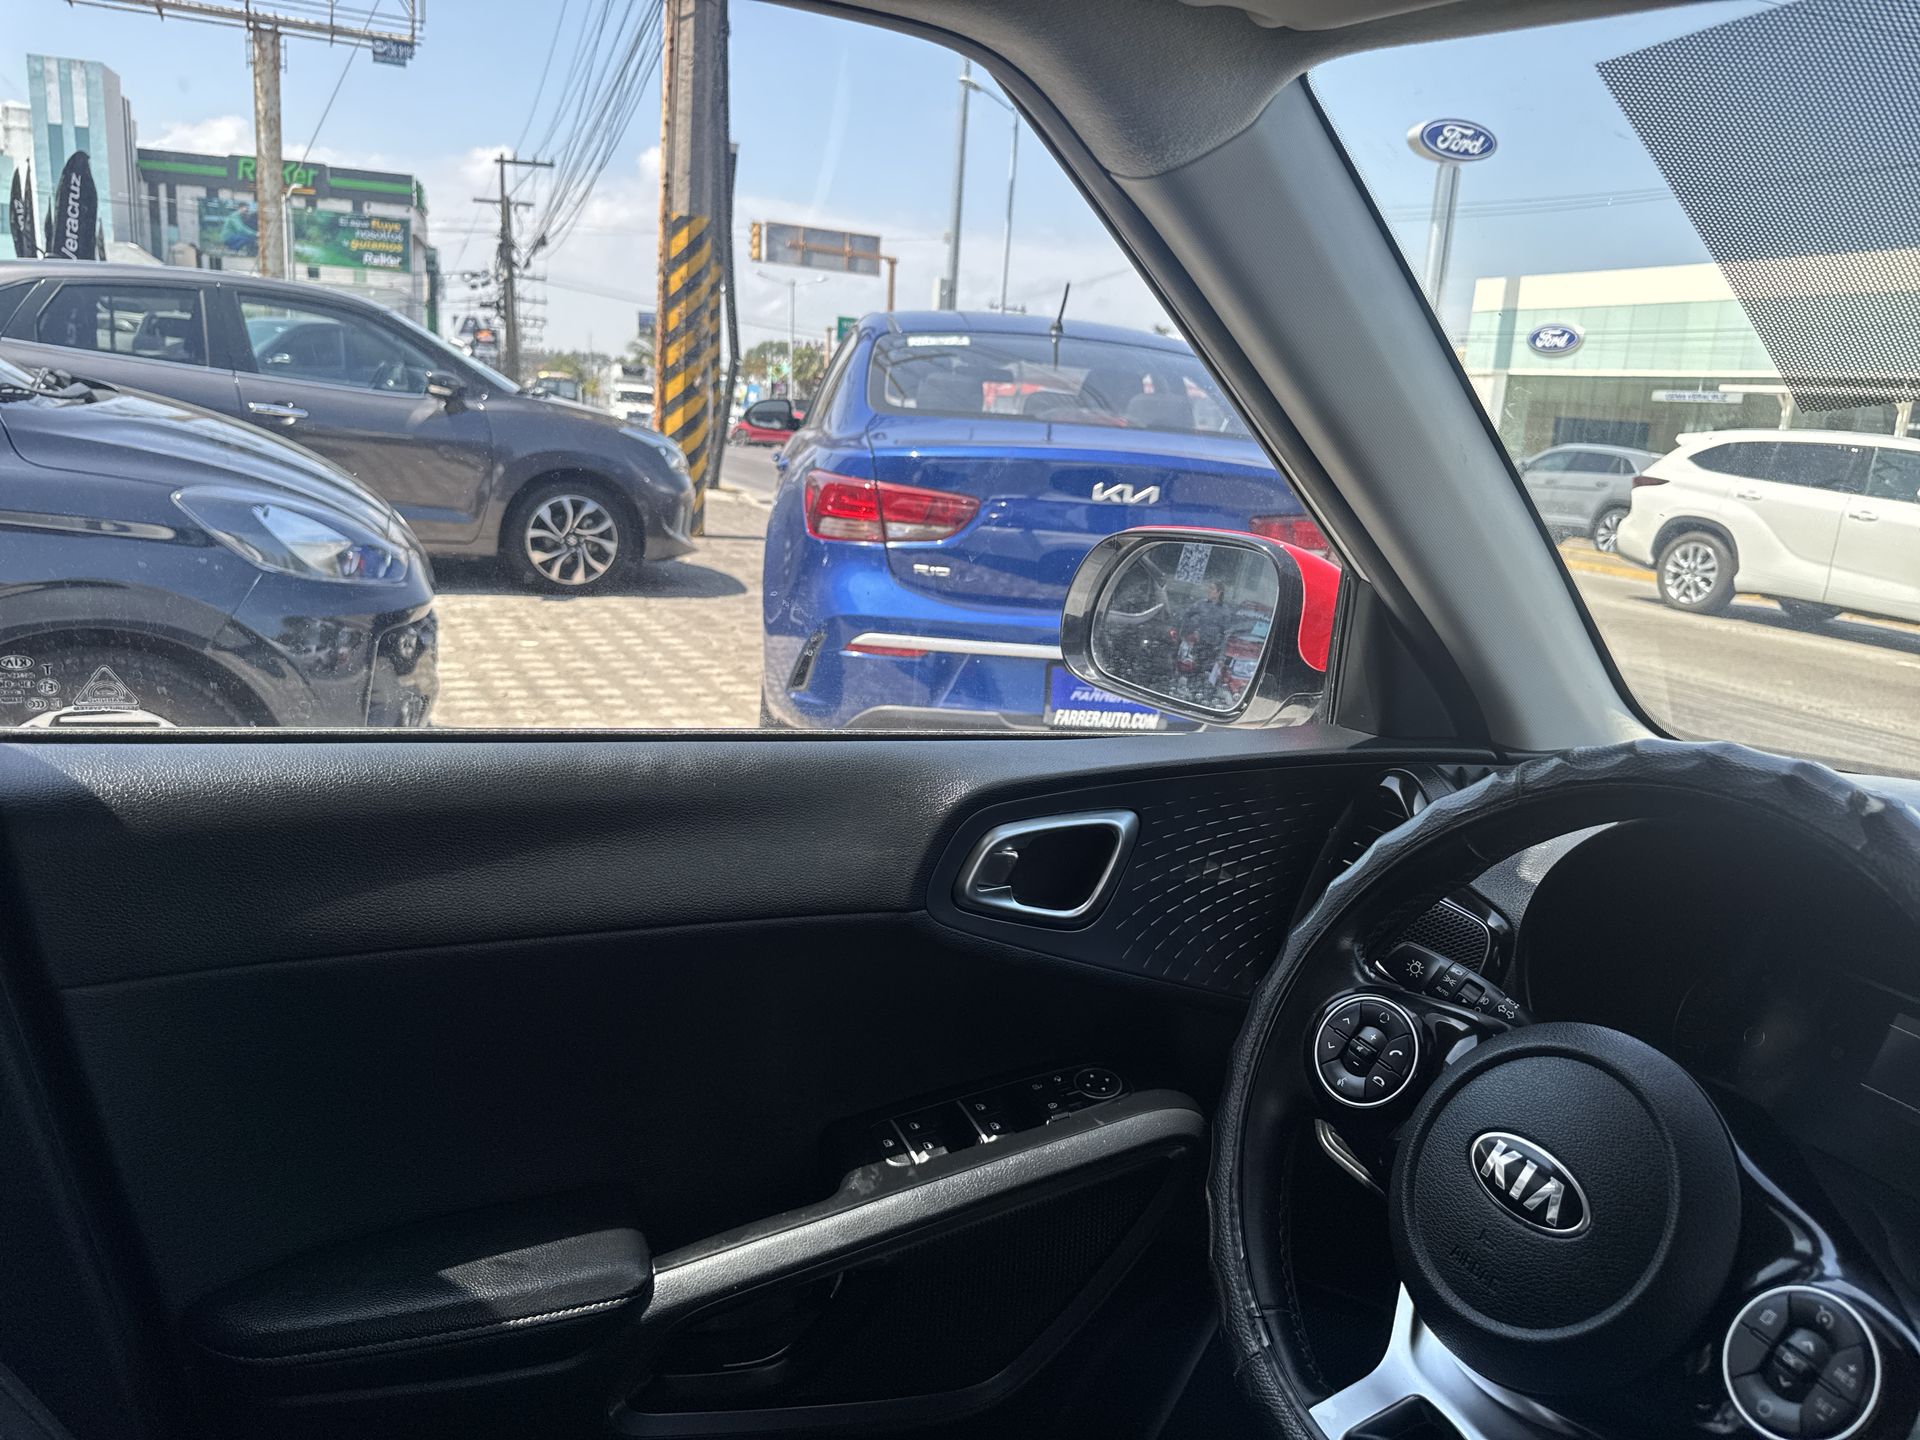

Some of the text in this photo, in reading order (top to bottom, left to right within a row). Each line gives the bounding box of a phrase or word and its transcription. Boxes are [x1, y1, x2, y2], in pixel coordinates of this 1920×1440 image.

[1437, 125, 1488, 155] Ford
[237, 157, 319, 187] RKer
[1535, 329, 1571, 348] Ford
[1054, 709, 1160, 730] FARRERAUTO.COM
[1480, 1139, 1565, 1227] KIA
